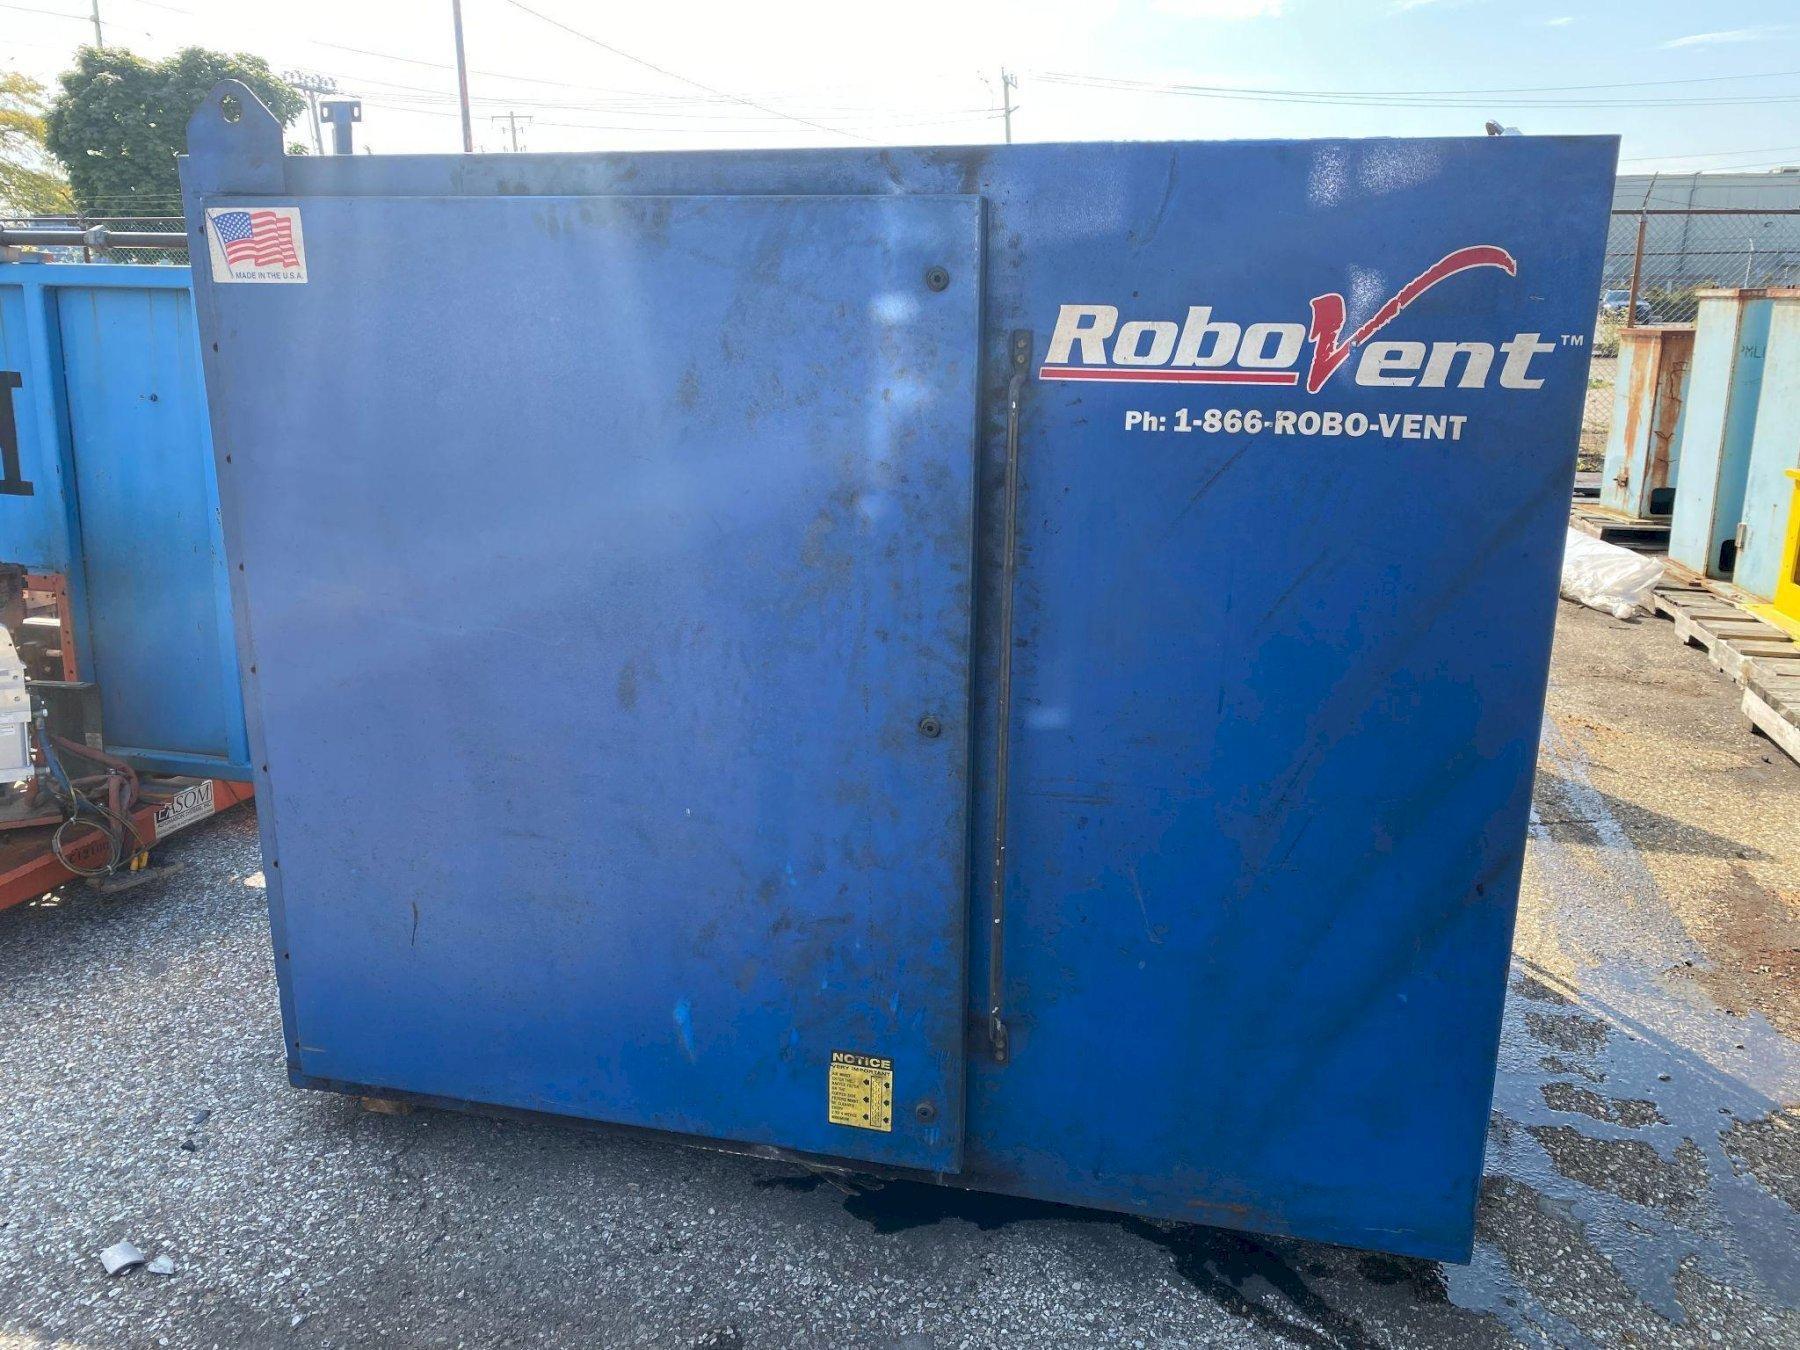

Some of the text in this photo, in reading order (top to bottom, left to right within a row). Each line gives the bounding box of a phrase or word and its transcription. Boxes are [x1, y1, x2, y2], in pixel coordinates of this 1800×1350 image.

[235, 271, 304, 280] MADE IN THE U.S.A.
[1124, 408, 1467, 441] Ph: 1-866-ROBO-VENT
[832, 1052, 891, 1070] NOTICE
